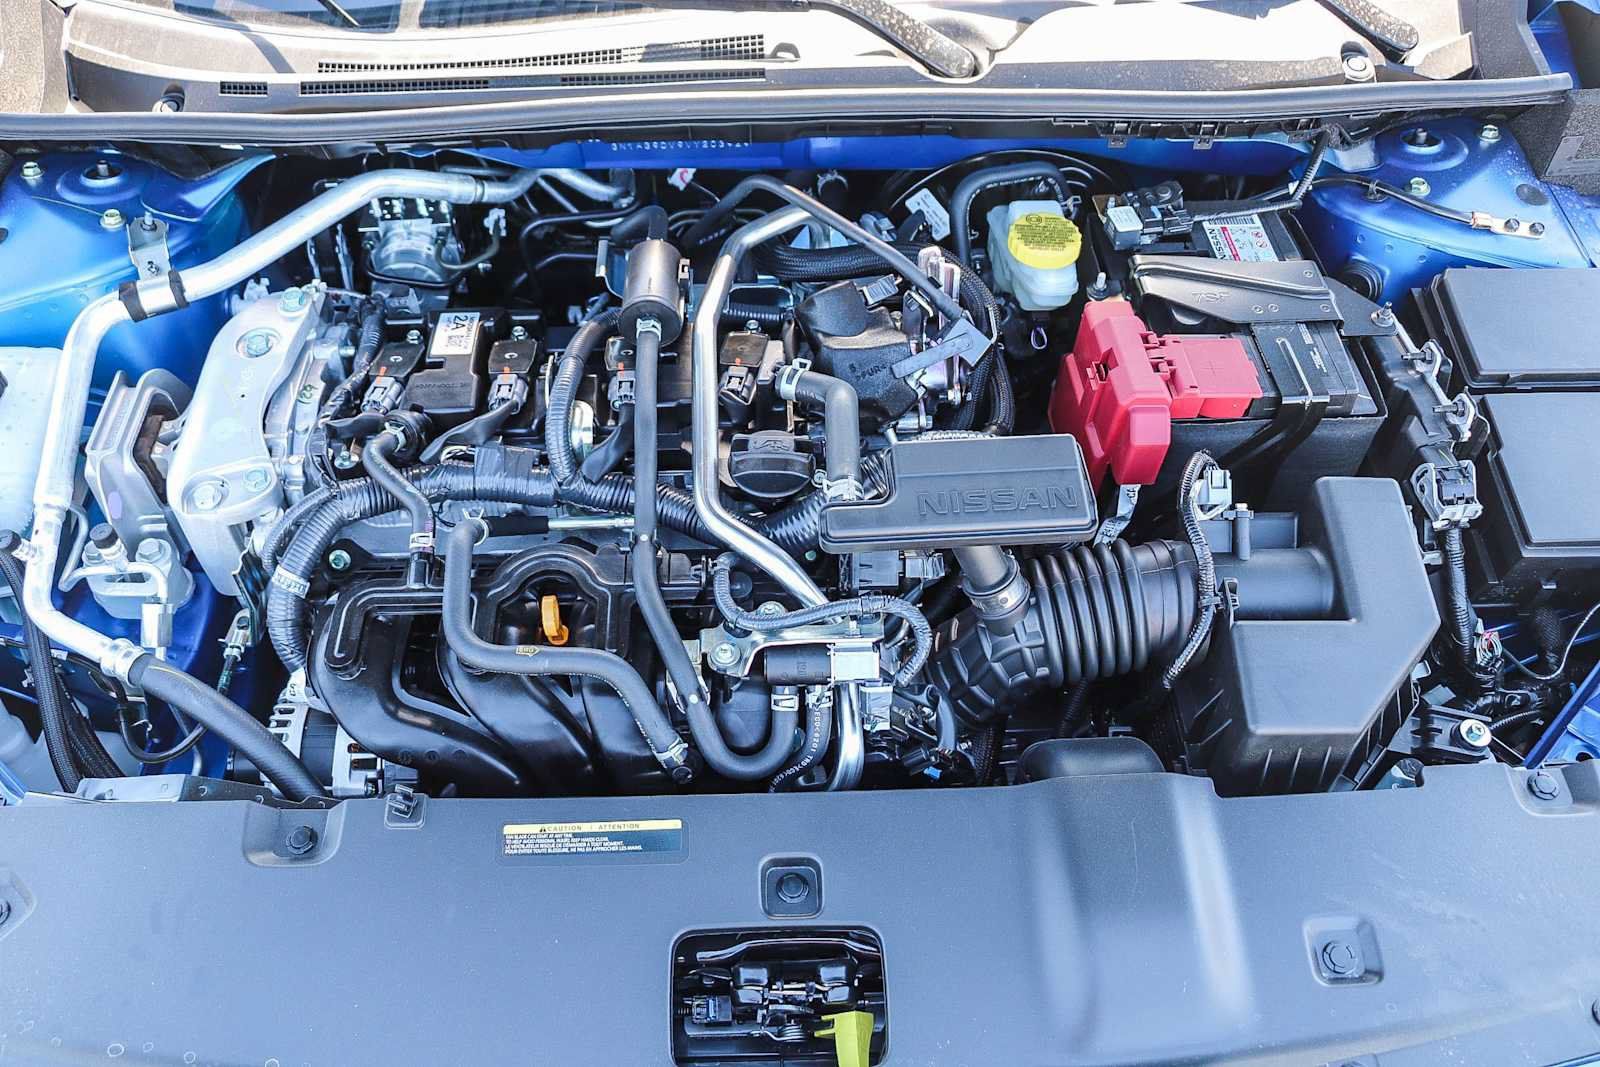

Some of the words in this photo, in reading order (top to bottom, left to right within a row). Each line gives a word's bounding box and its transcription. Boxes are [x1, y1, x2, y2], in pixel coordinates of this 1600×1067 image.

[1208, 228, 1226, 260] NISSAN
[451, 315, 469, 331] 2A
[917, 486, 1078, 515] NISSAN
[598, 823, 640, 831] ATTENTION
